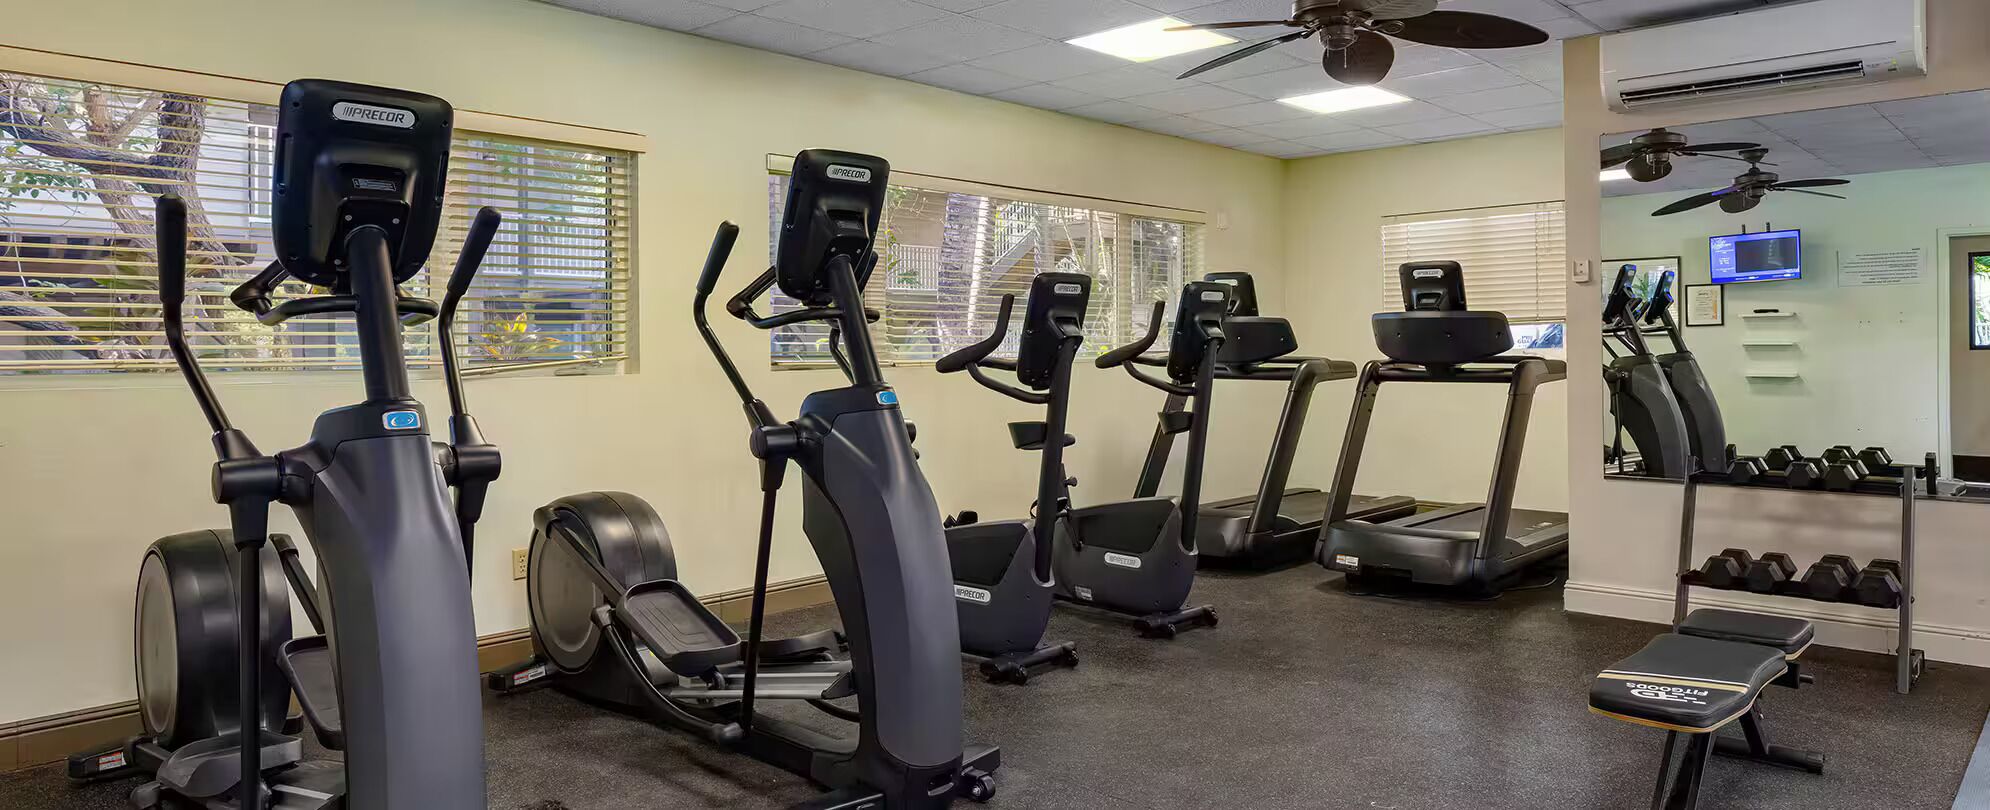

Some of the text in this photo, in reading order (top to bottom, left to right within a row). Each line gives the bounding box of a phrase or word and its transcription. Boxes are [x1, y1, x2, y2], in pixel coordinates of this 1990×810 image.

[351, 107, 405, 123] PRECOR
[837, 168, 866, 179] PRECOR
[960, 589, 985, 600] PRECOR
[1626, 682, 1708, 696] FITGOODS
